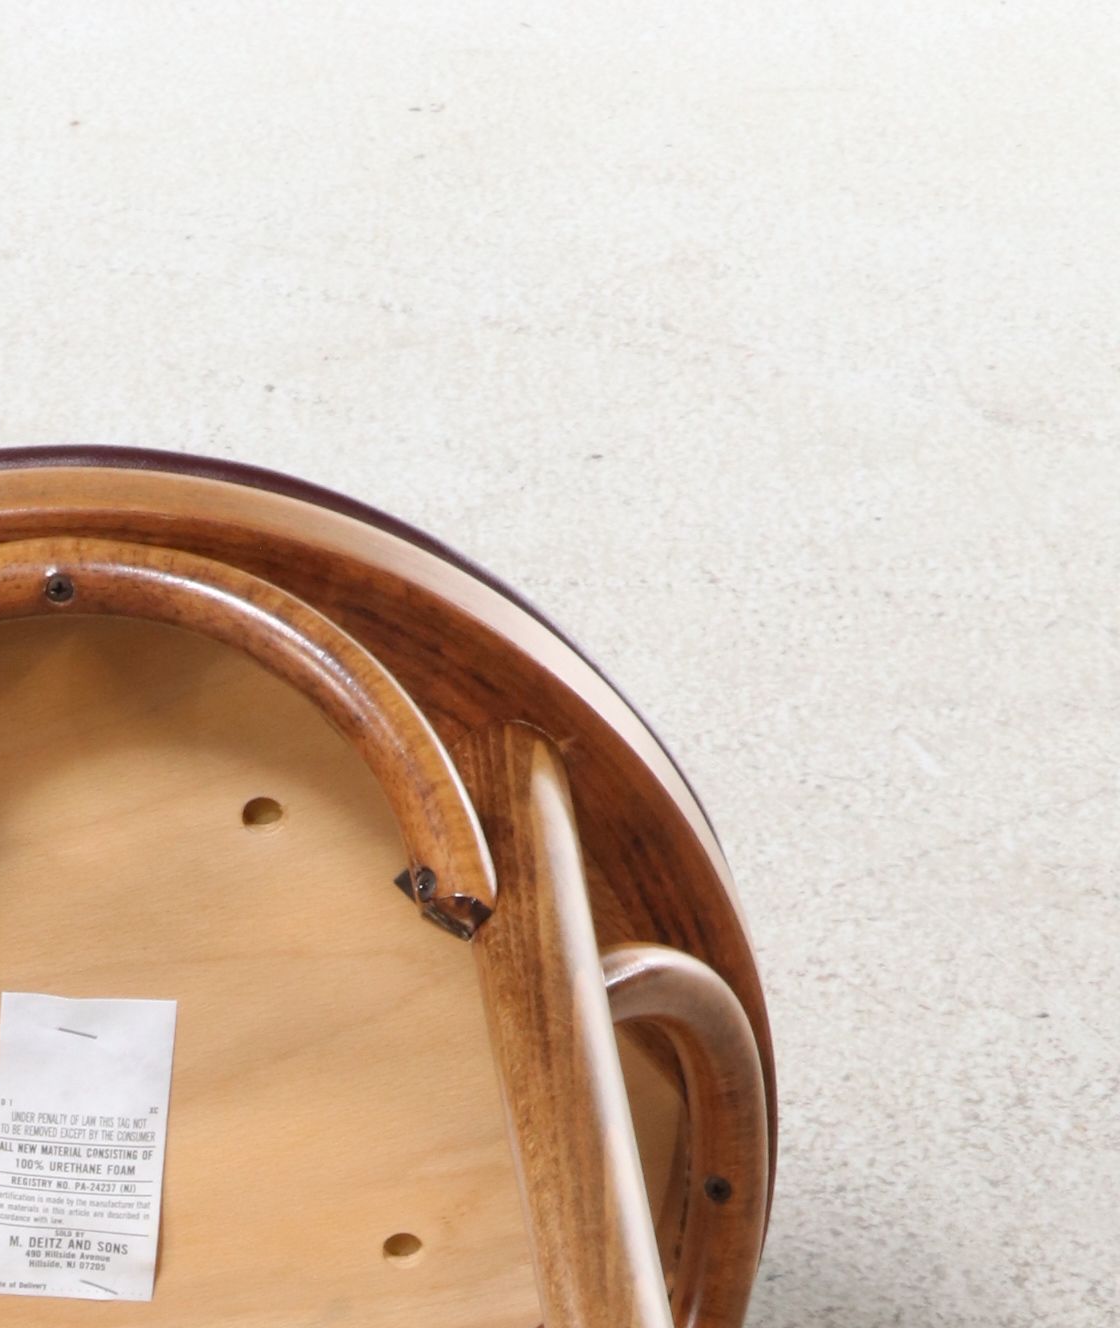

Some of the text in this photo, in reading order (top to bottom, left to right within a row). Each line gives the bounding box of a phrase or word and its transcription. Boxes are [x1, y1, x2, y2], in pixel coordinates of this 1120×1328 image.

[12, 1111, 147, 1129] UNDER PENALTY OF LAW THIS TAG NOT
[0, 1123, 156, 1142] TO BE REMOVED EXCEPT BY THE CONSUMER
[0, 1141, 153, 1160] ALL NEW MATERIAL CONSISTING OF
[16, 1158, 136, 1176] 100% URETHANE FOAM
[11, 1176, 53, 1188] REGISTRY
[46, 1196, 64, 1204] made
[66, 1198, 74, 1206] by
[89, 1200, 135, 1209] manufacturer
[136, 1201, 151, 1209] that
[7, 1203, 39, 1213] materials
[42, 1205, 49, 1213] in
[52, 1206, 65, 1215] this
[69, 1208, 90, 1217] article
[107, 1211, 140, 1220] described
[9, 1235, 128, 1255] M. DEITZ AND SONS
[29, 1260, 63, 1269] Hillside,
[66, 1261, 76, 1269] NJ
[44, 1250, 76, 1259] Hillside
[80, 1252, 111, 1262] Avenue
[19, 1281, 47, 1290] Delivery
